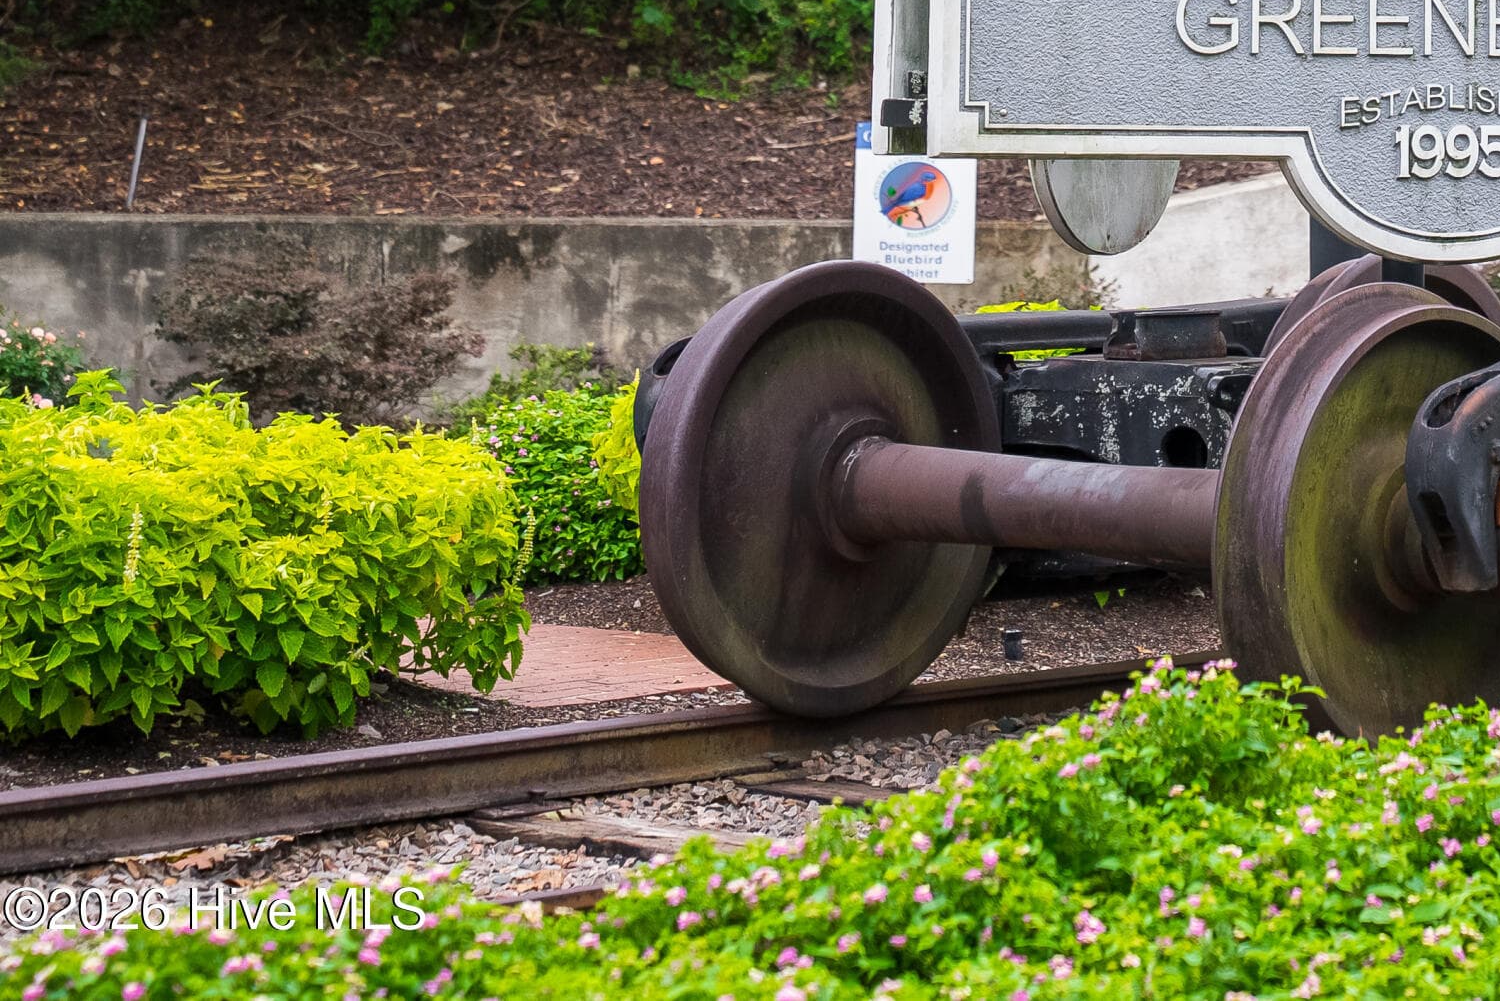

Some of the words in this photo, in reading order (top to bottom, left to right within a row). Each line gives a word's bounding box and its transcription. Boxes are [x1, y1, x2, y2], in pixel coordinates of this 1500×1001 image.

[879, 240, 949, 253] Designated
[885, 254, 942, 264] Bluebird
[901, 268, 939, 278] bitat
